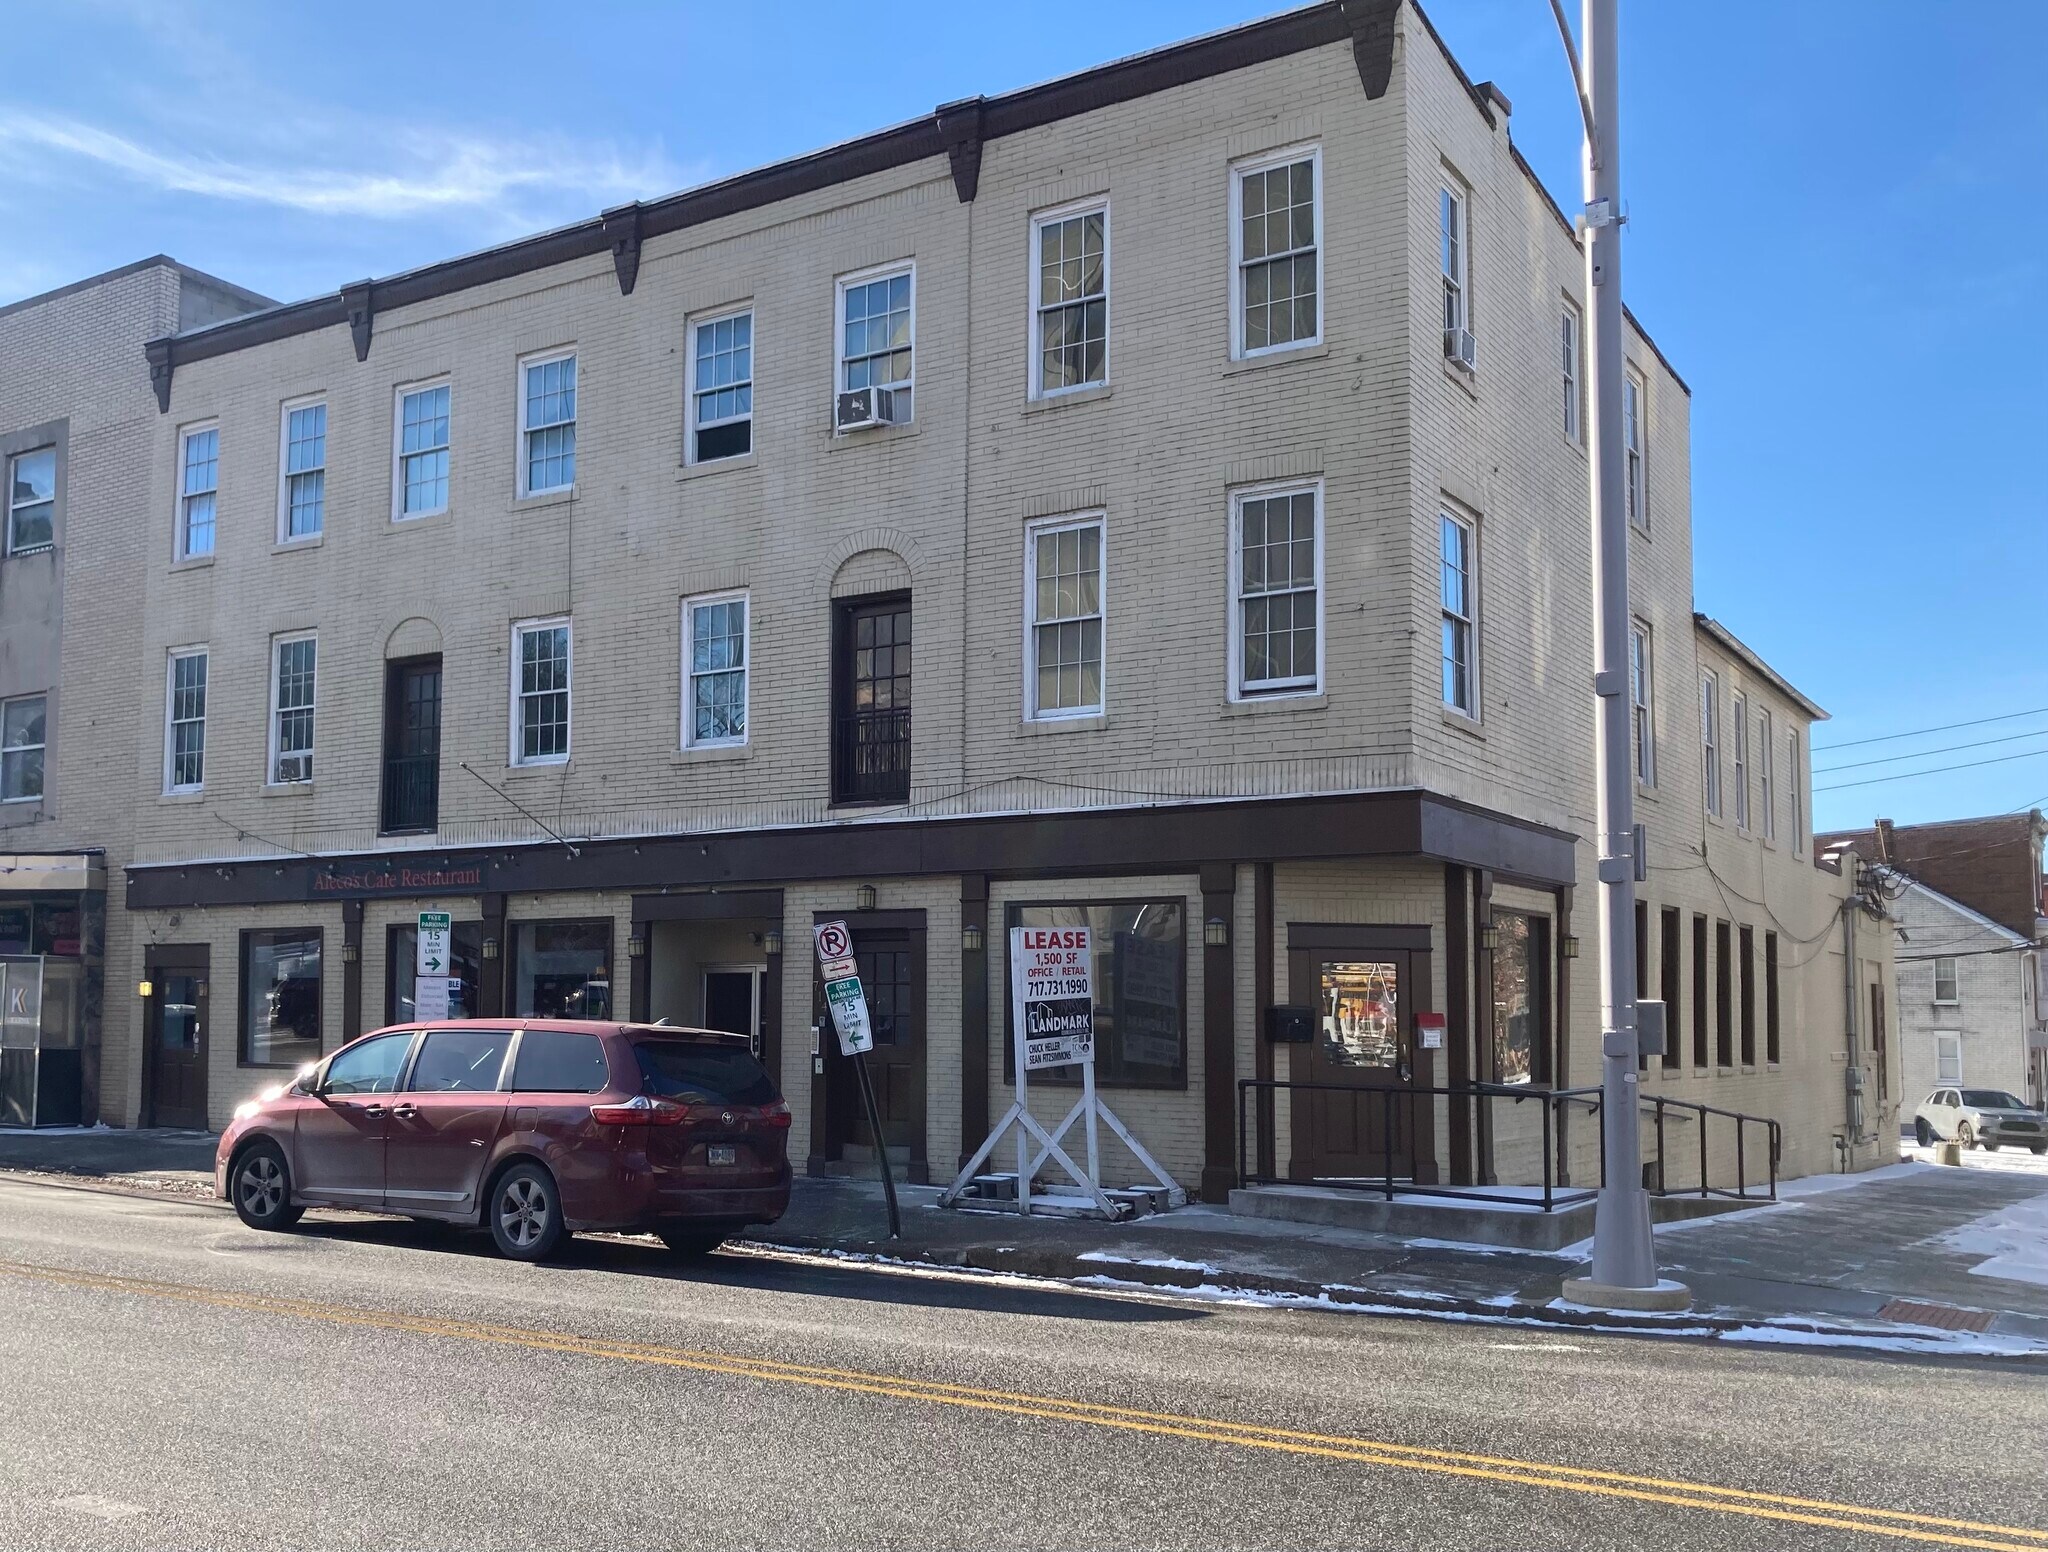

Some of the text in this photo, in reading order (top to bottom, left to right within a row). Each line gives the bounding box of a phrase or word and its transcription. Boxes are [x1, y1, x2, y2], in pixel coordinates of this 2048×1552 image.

[365, 870, 397, 888] Cafe
[401, 867, 481, 887] Restaurant
[428, 932, 440, 940] 15
[1024, 931, 1087, 949] LEASE
[1035, 952, 1078, 965] 1,500 SF
[1028, 968, 1053, 978] OFFICE
[1062, 967, 1086, 975] RETAIL
[836, 981, 851, 990] FREE
[1028, 979, 1088, 997] 717.731.1990
[831, 987, 859, 1000] PARKING
[841, 1000, 856, 1012] 15
[843, 1012, 858, 1021] MIN
[843, 1020, 862, 1029] LIMIT
[1031, 1014, 1090, 1033] LANDMARK
[1029, 1044, 1044, 1054] CHUCK
[1029, 1055, 1041, 1065] SEAN
